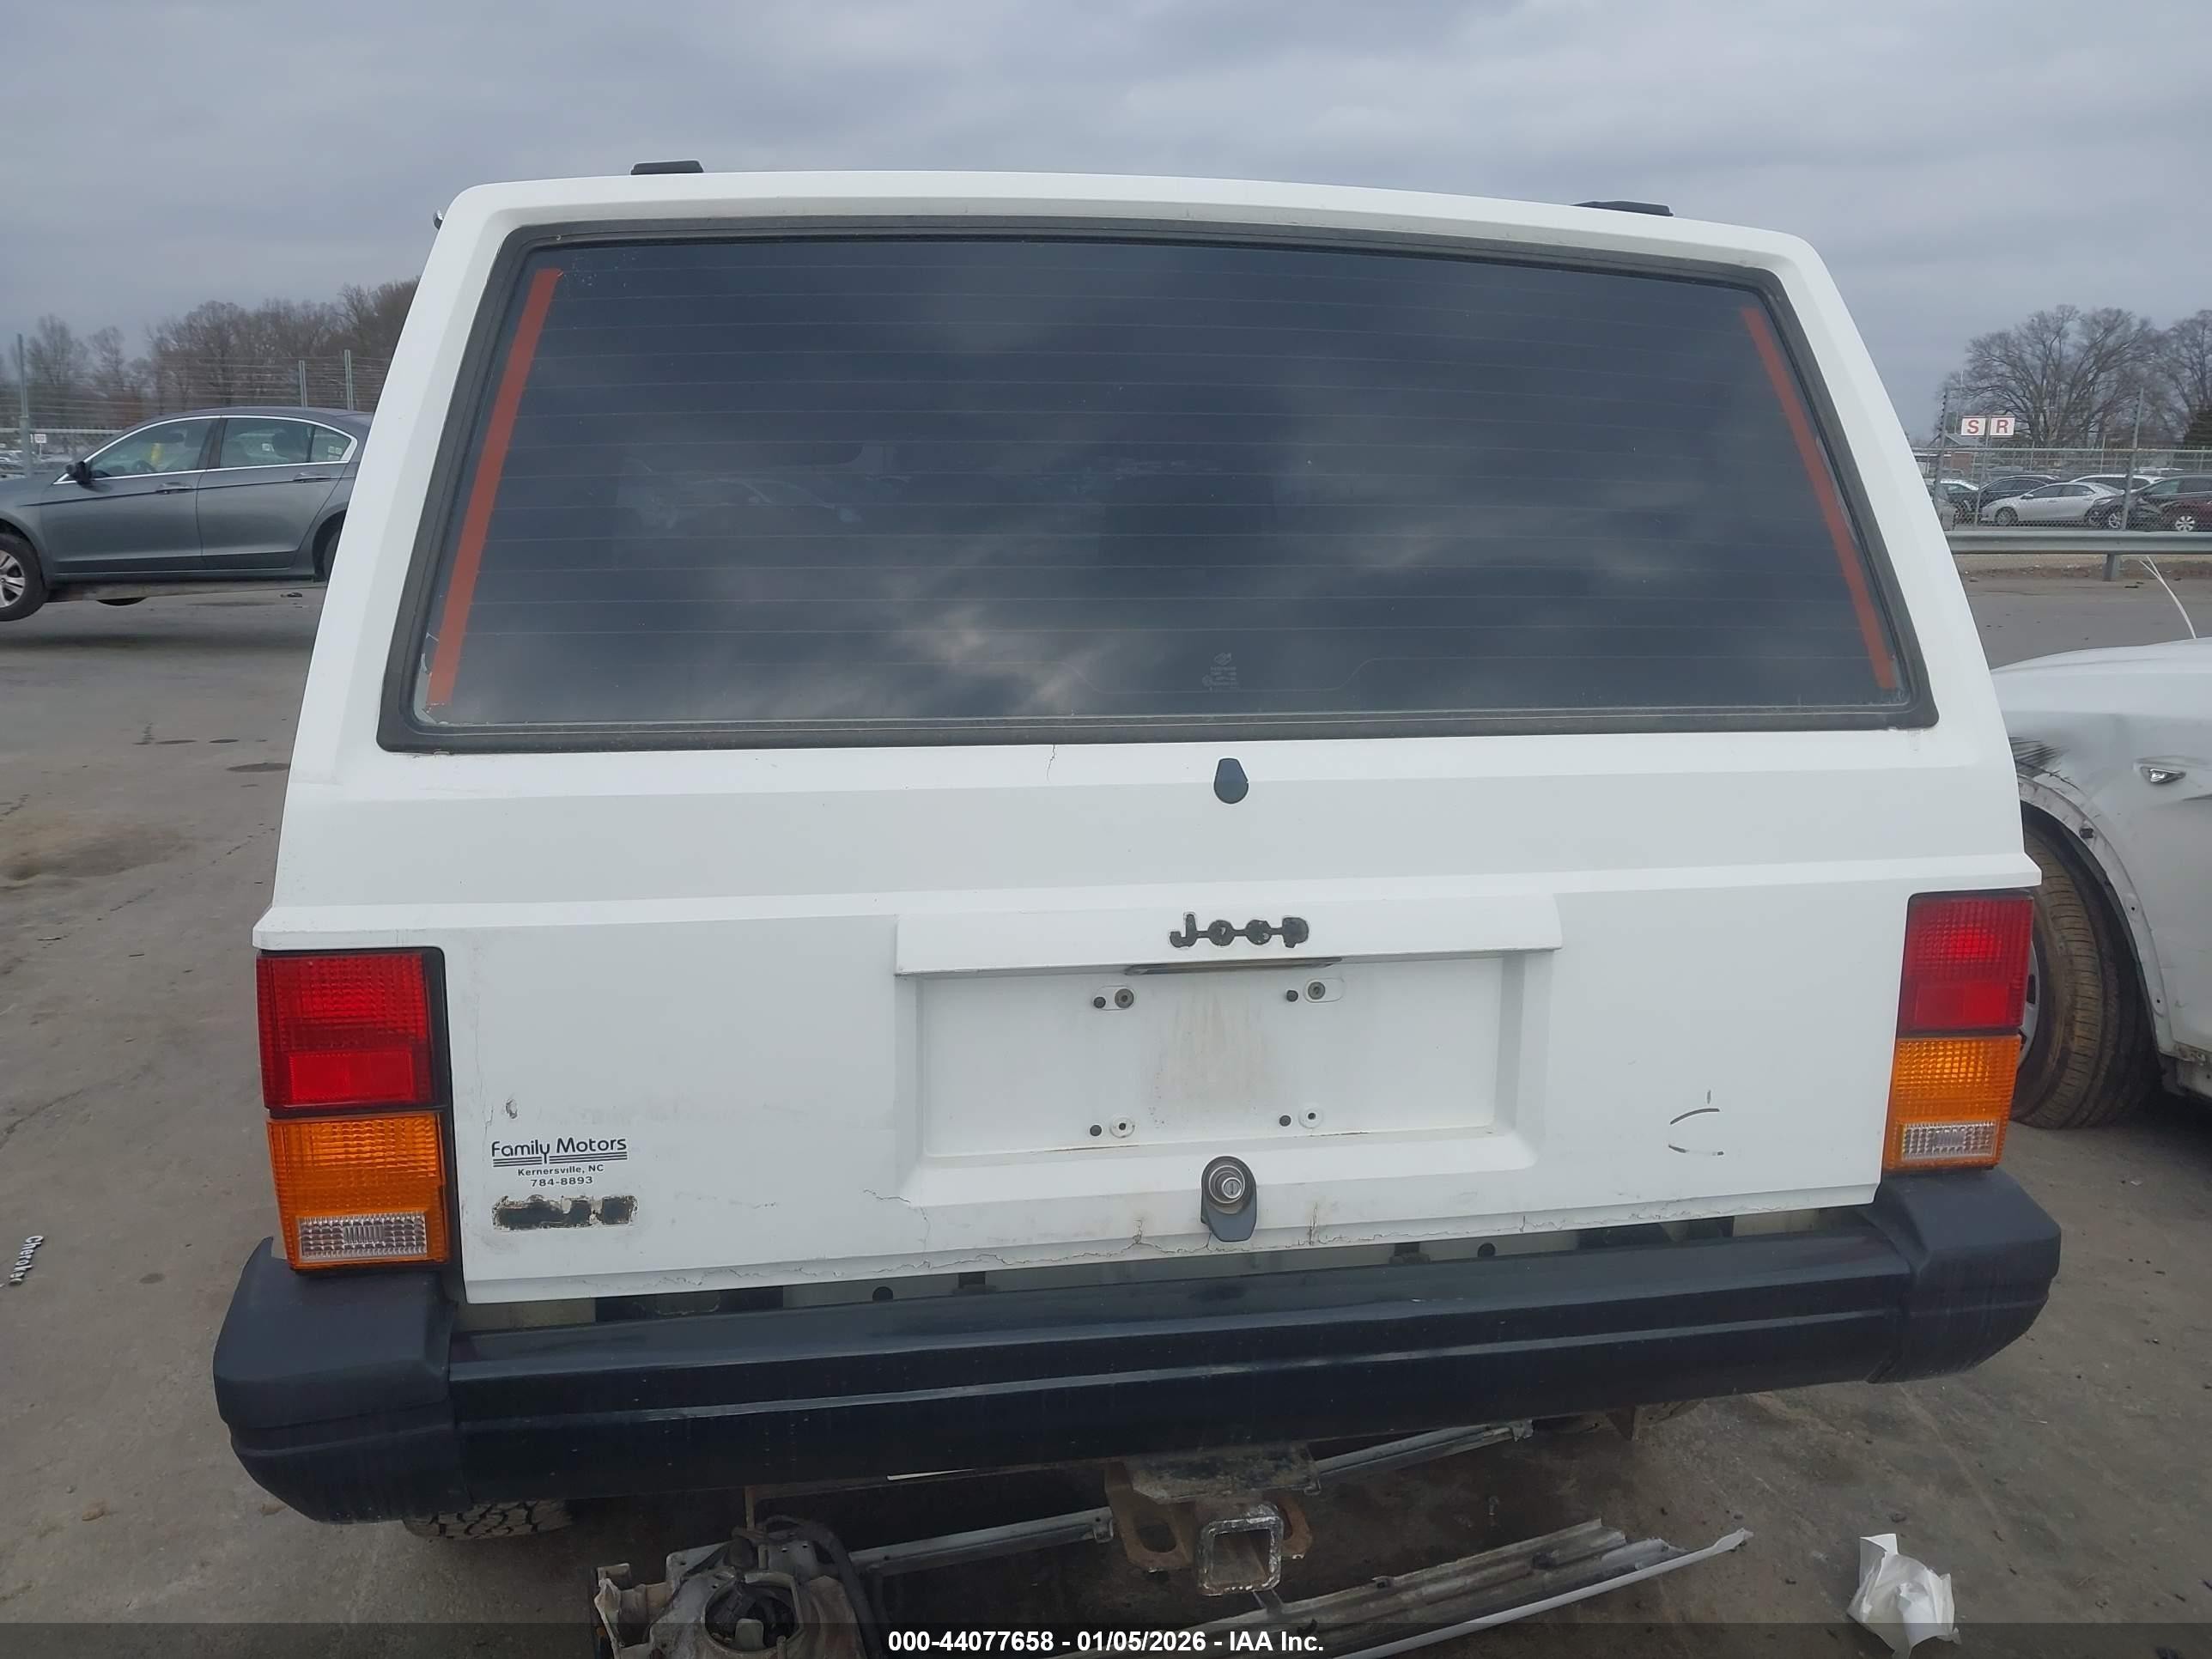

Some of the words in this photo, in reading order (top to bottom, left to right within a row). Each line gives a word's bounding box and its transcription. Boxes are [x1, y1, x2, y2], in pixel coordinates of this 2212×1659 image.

[1967, 420, 1979, 434] S
[1996, 419, 2008, 434] R
[490, 1139, 550, 1164] Family
[556, 1137, 628, 1154] Motors
[517, 1165, 586, 1176] Kernersville,
[588, 1164, 605, 1173] NC
[530, 1176, 593, 1188] 784-8893
